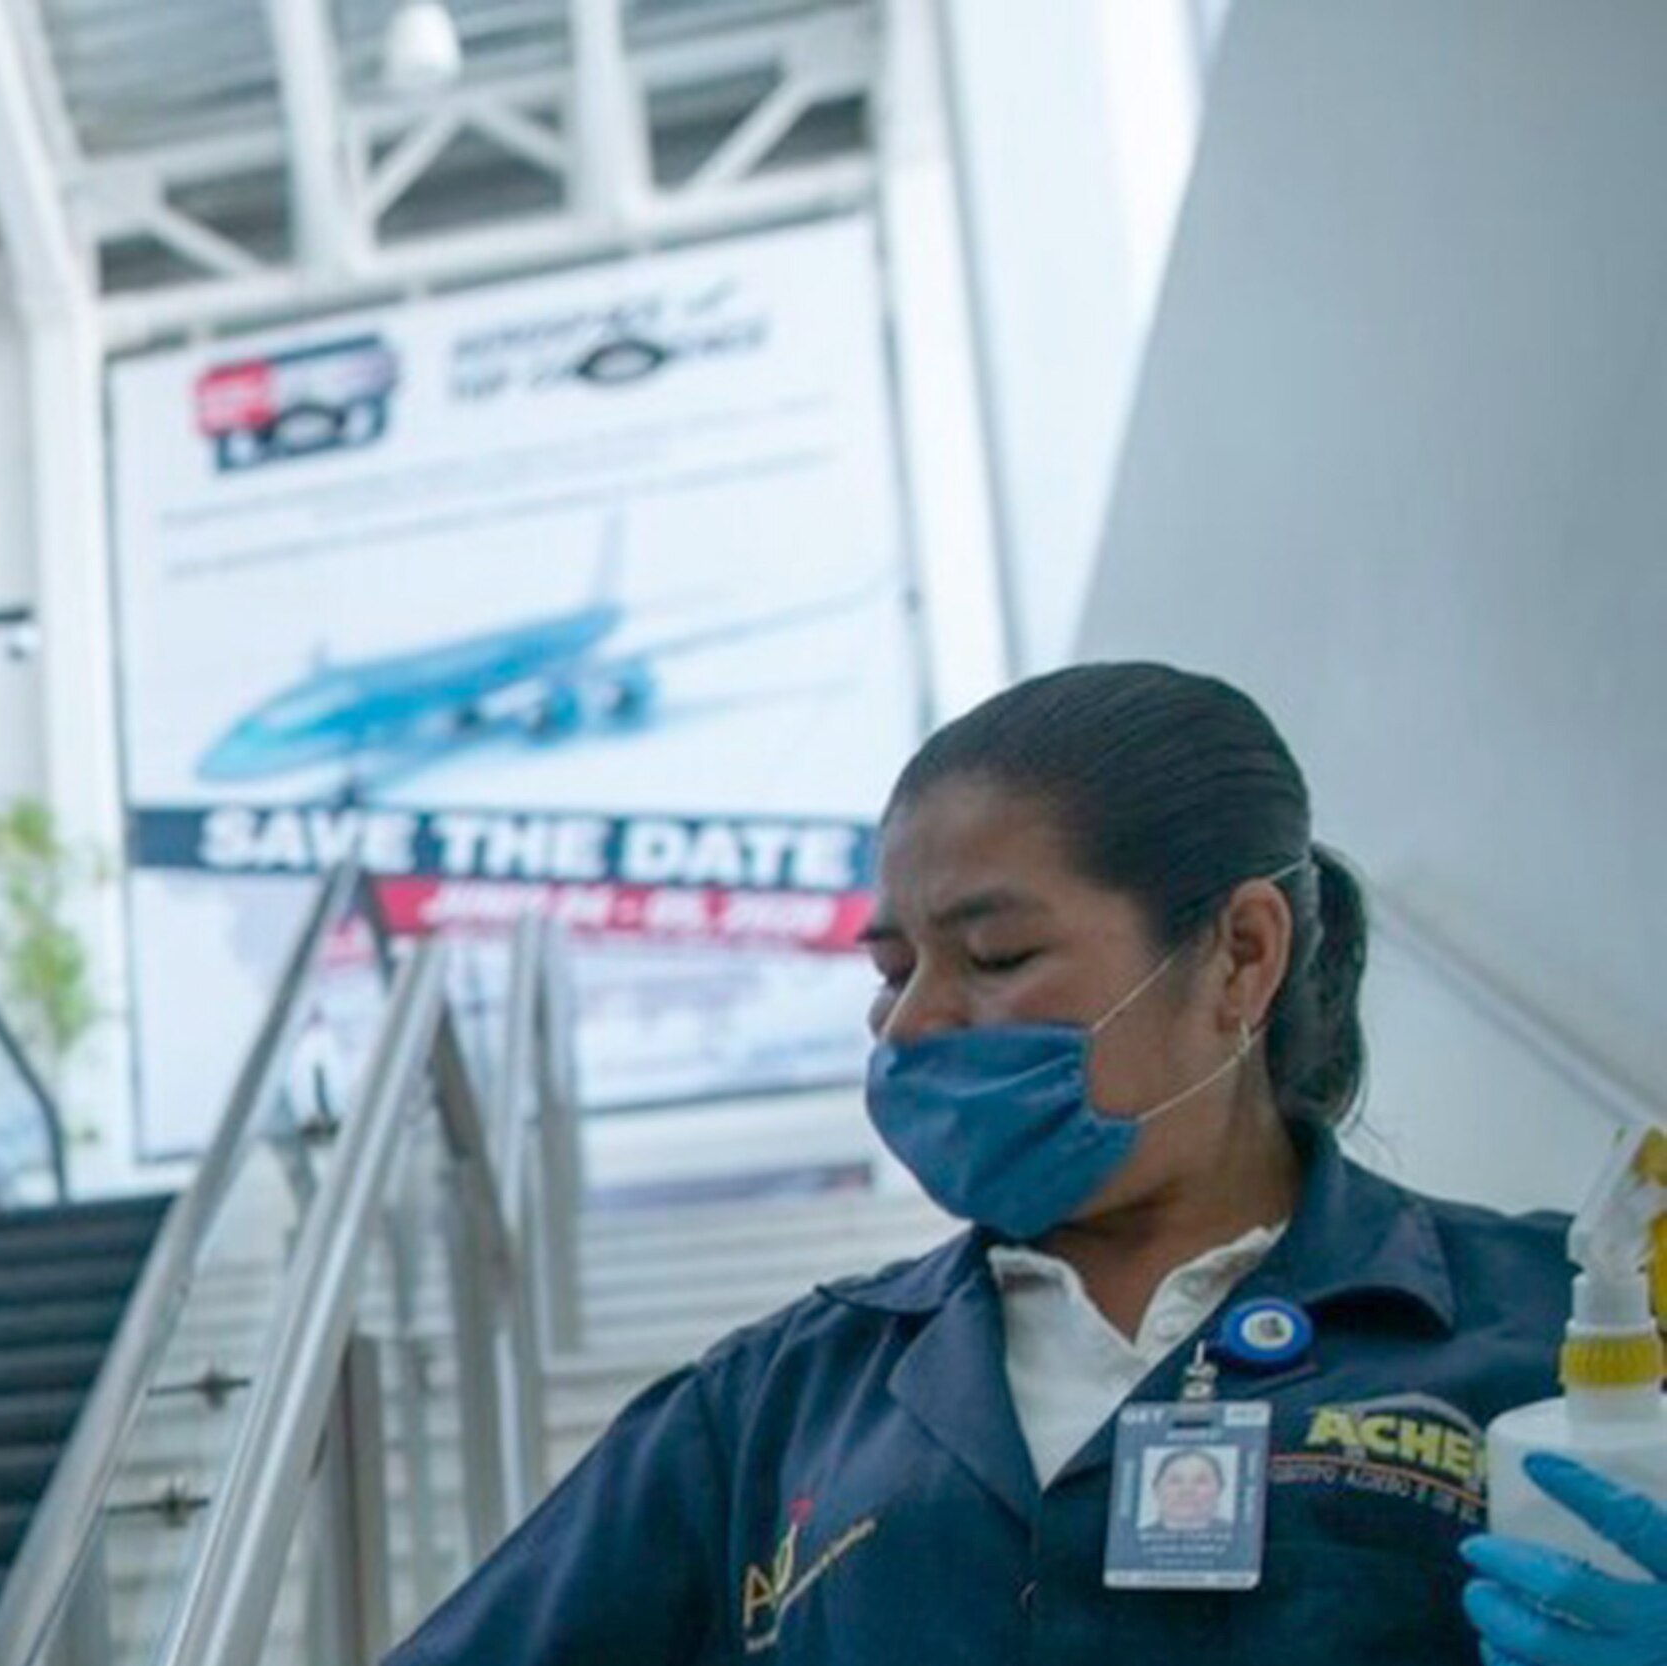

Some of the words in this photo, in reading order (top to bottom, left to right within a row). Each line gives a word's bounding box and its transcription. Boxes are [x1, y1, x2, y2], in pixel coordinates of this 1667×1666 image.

[199, 807, 414, 872] SAVE
[432, 812, 609, 877] THE
[622, 819, 856, 887] DATE
